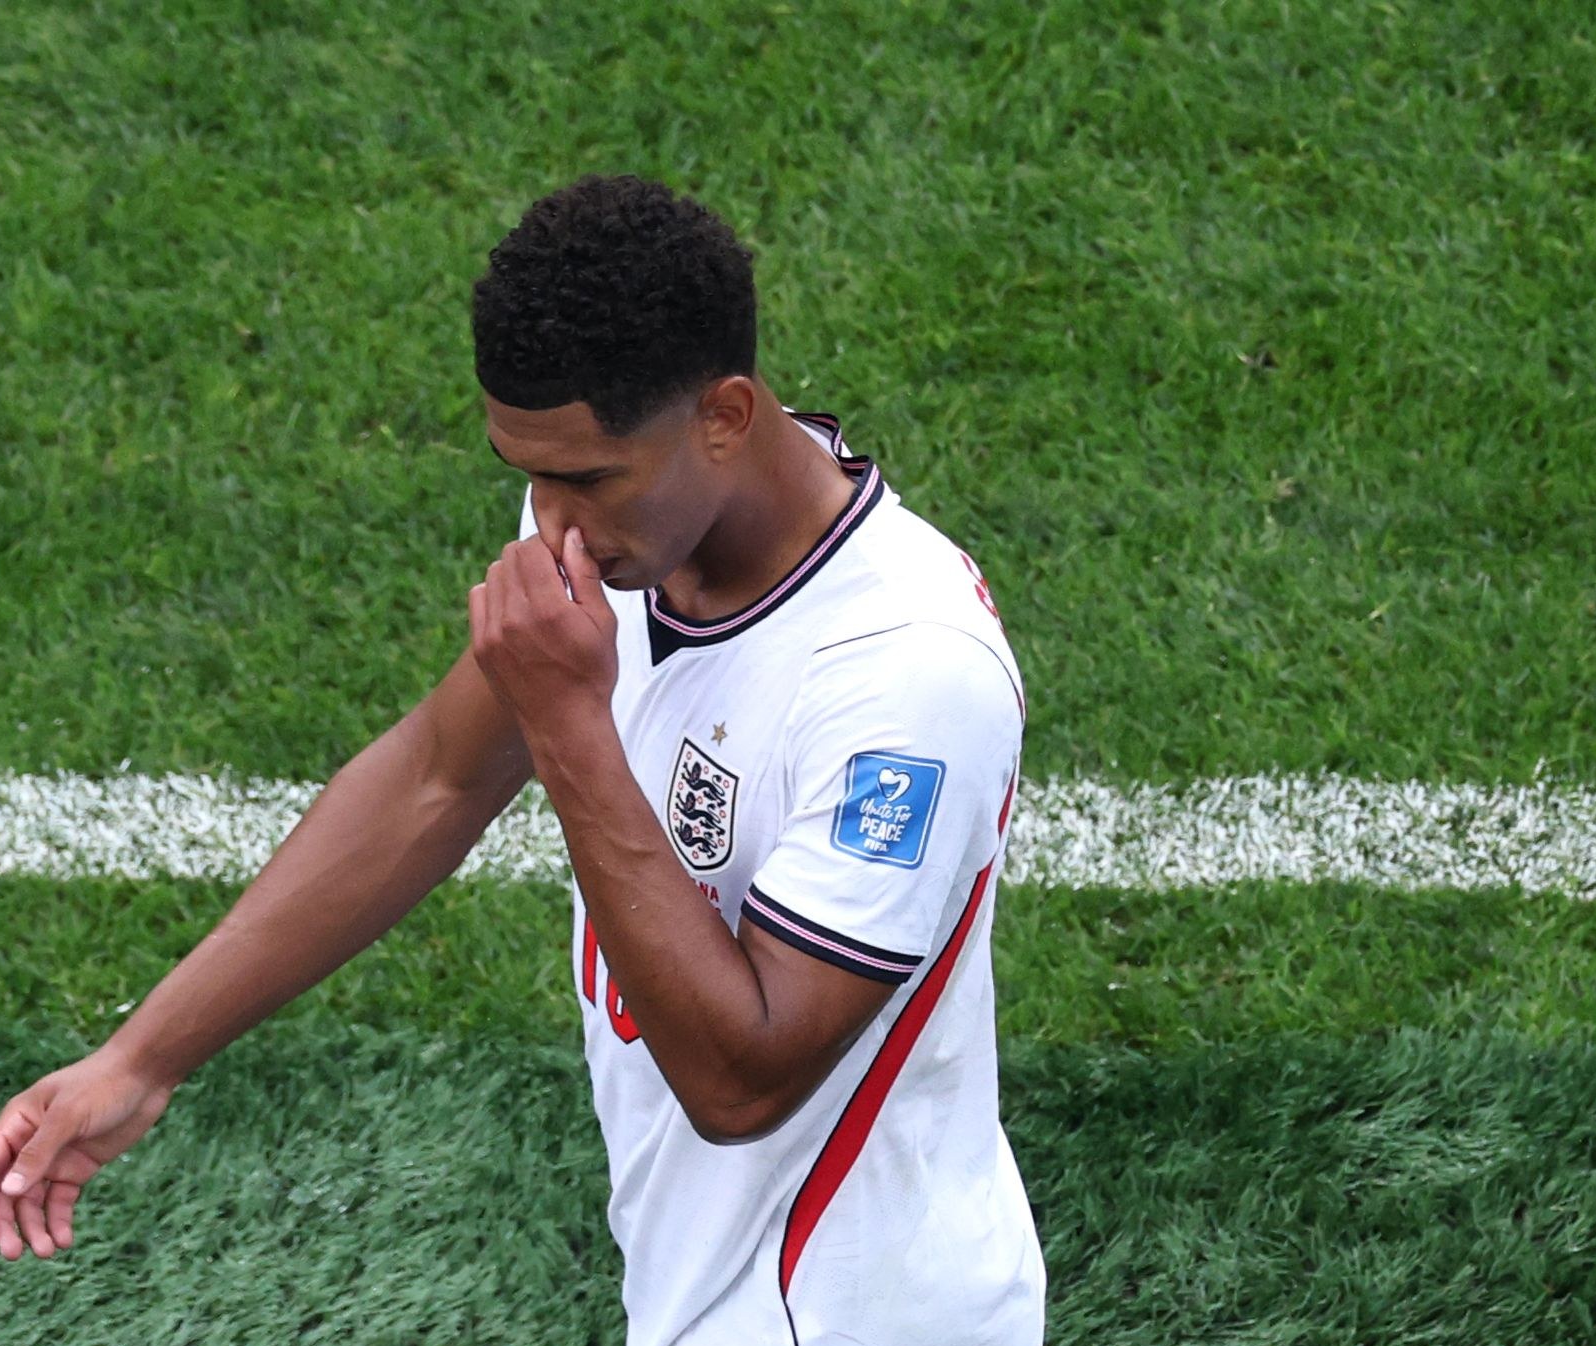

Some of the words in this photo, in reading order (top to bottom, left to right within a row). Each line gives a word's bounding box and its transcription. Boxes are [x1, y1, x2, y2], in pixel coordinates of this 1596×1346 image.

[859, 797, 893, 821] Unite
[893, 804, 913, 823] For
[859, 816, 905, 842] PEACE
[863, 838, 889, 852] FIFA
